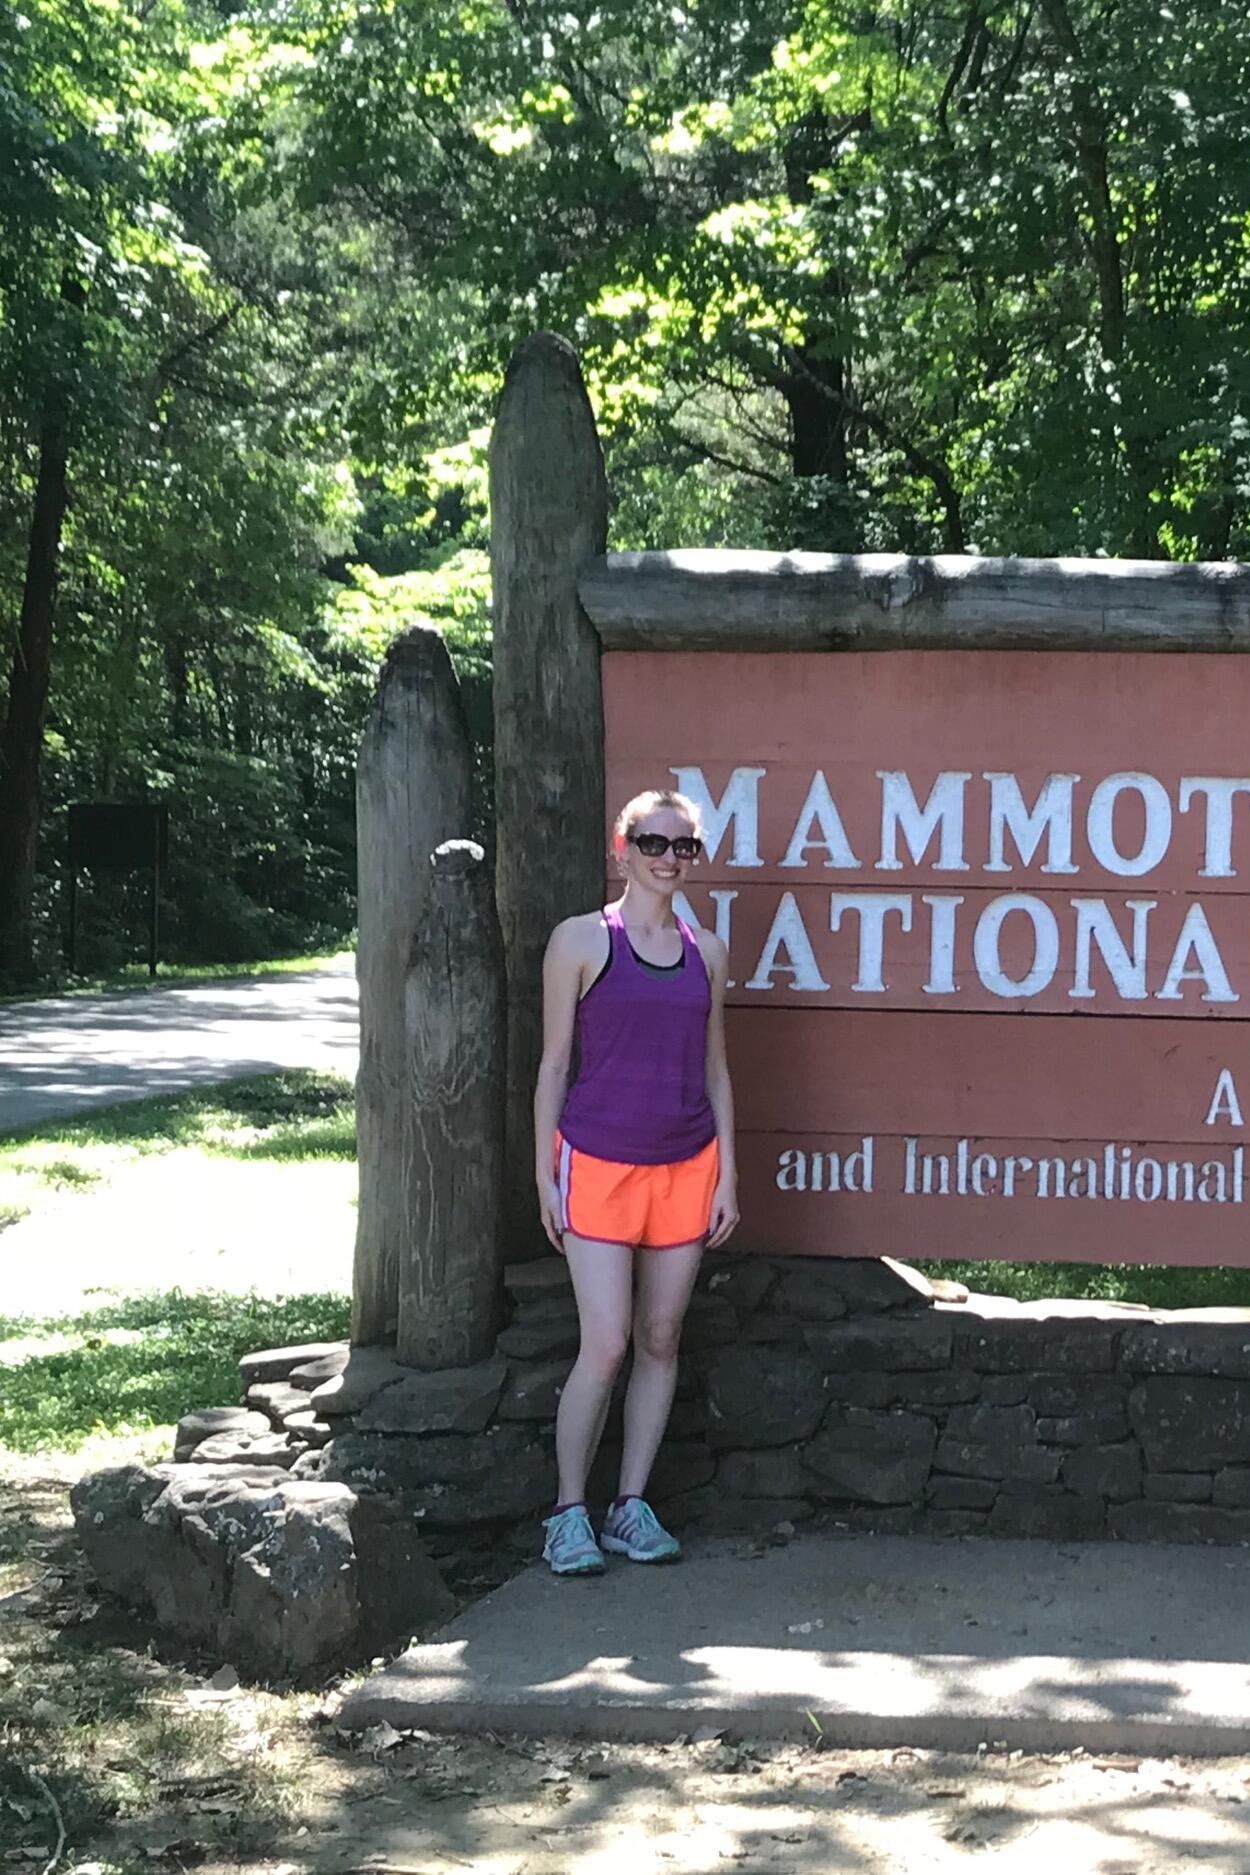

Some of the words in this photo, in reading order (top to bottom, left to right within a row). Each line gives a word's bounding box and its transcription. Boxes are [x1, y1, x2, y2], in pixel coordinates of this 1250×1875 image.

[1206, 1069, 1244, 1127] A
[777, 1137, 873, 1192] and
[904, 1139, 1244, 1203] International
